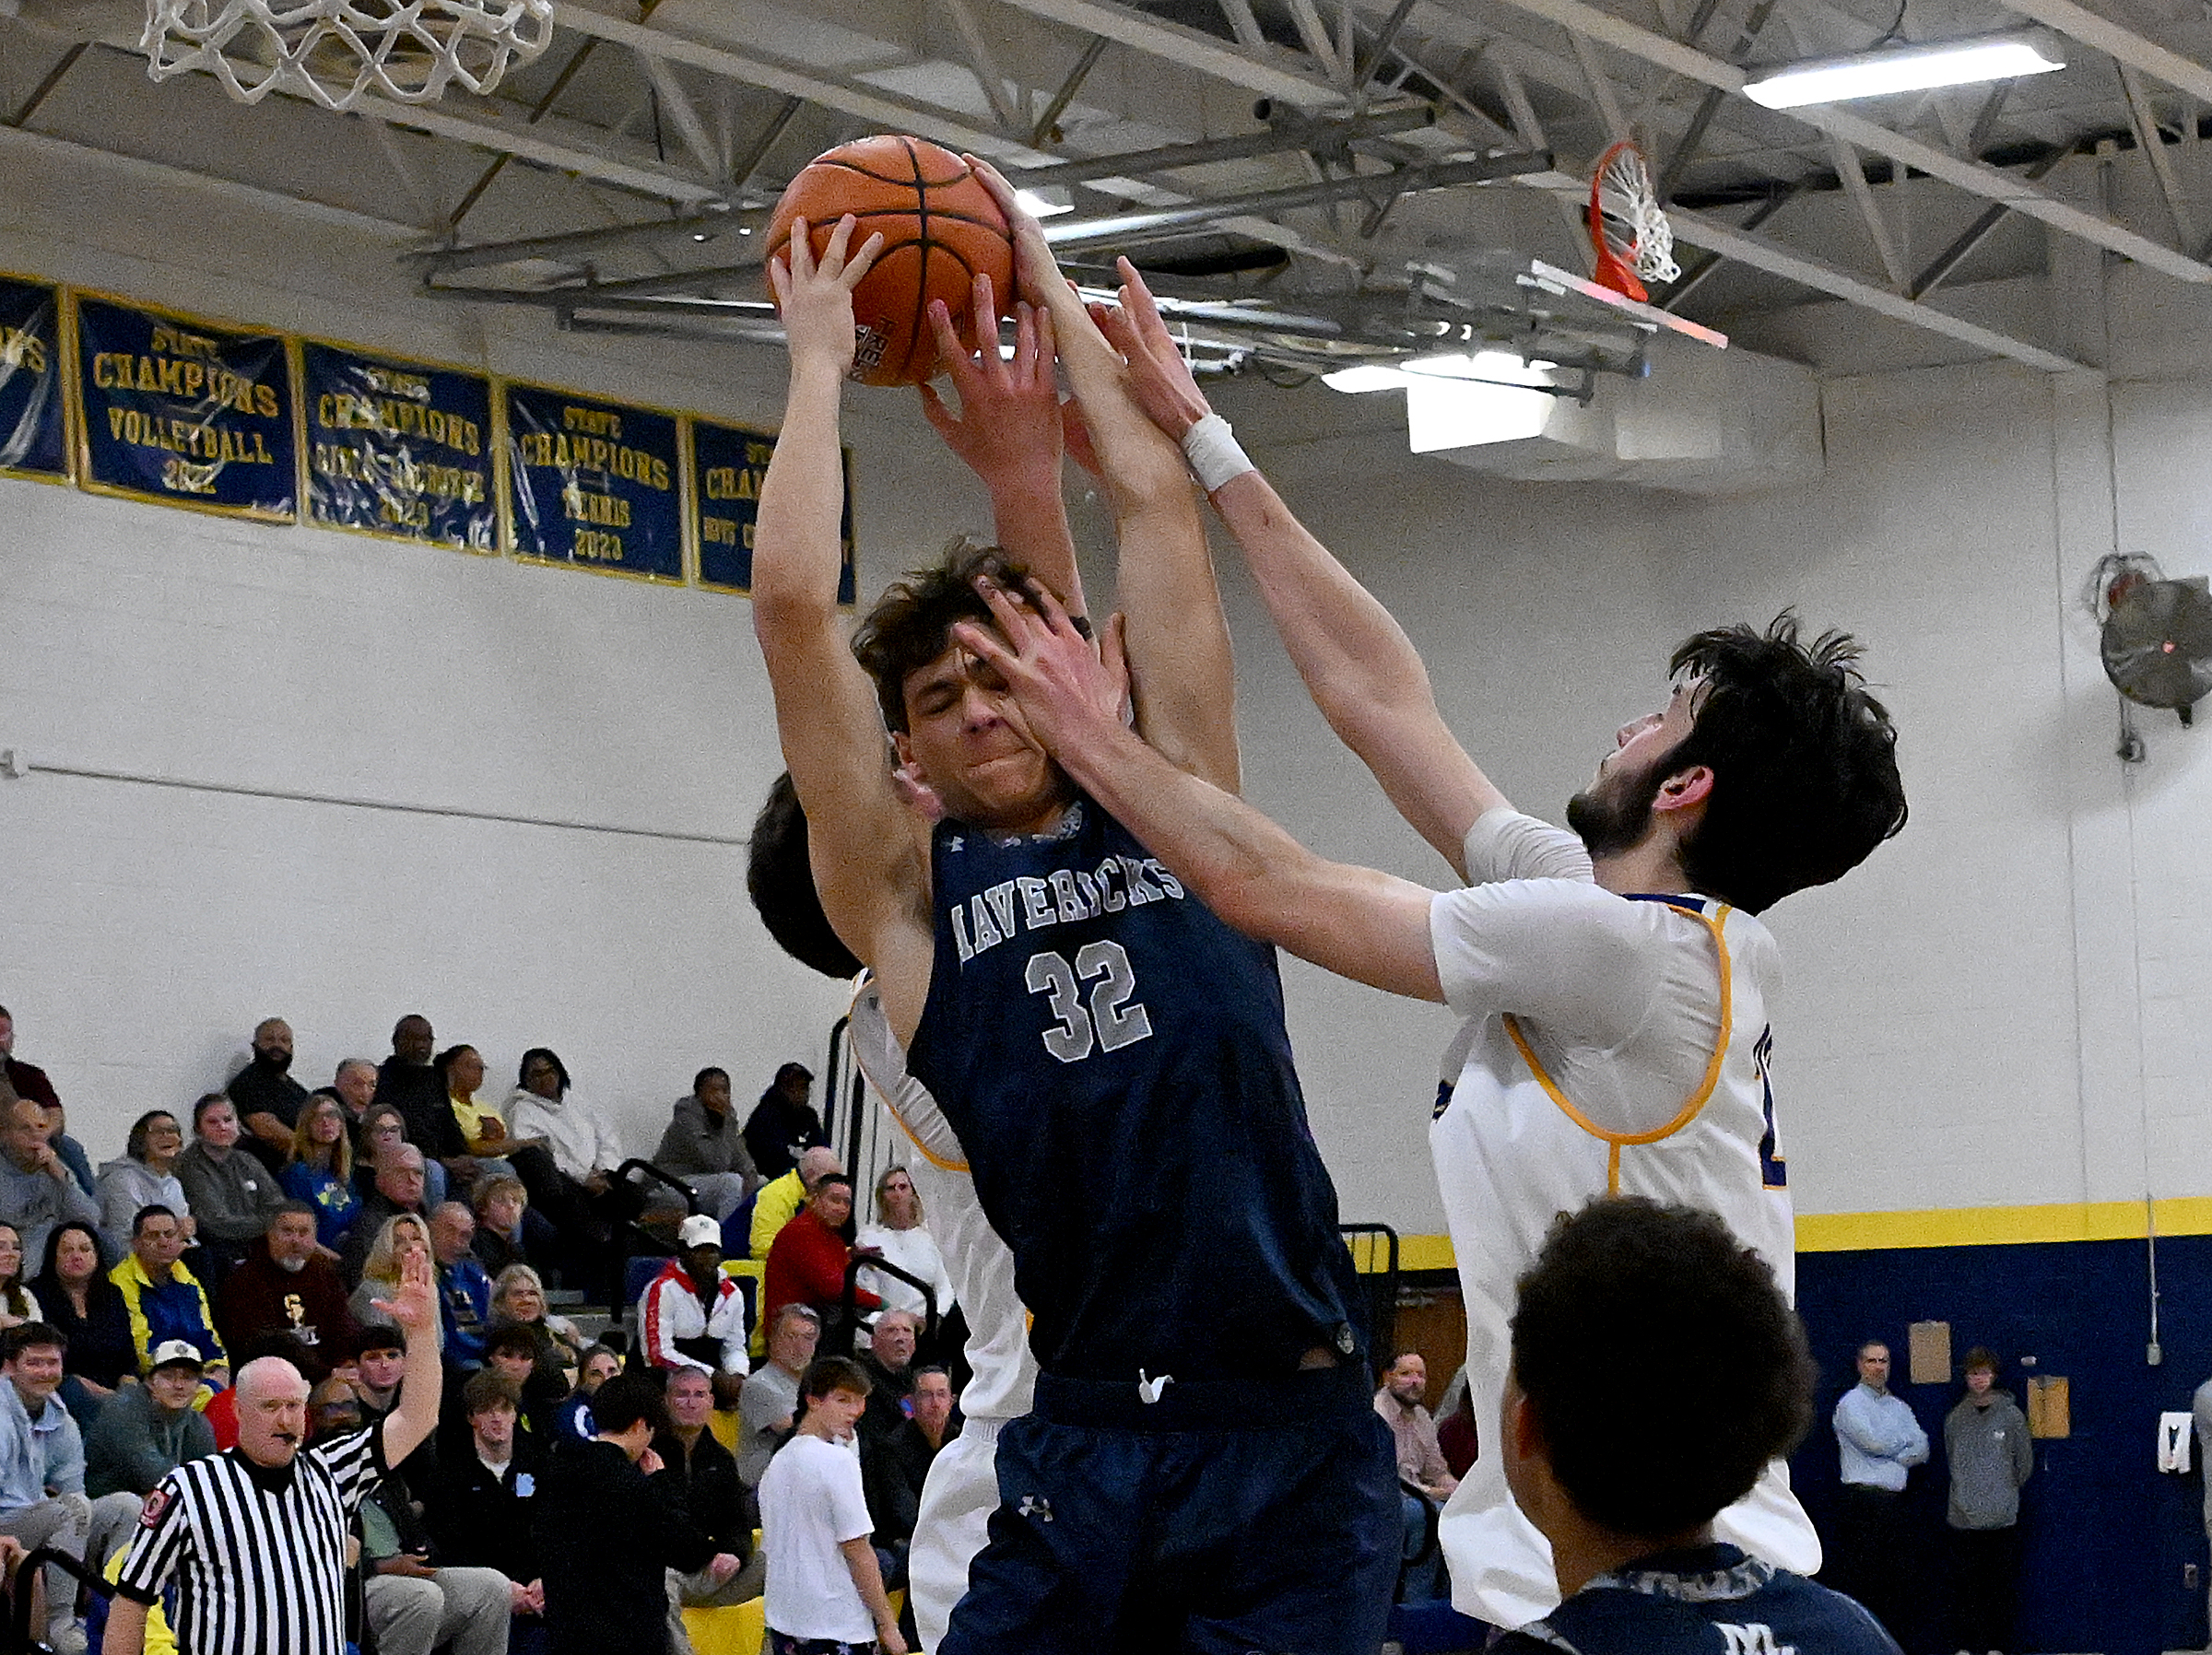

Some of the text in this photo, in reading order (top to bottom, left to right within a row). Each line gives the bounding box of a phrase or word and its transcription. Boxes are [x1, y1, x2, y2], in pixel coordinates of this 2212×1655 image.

[94, 352, 279, 417] CHAMPIONS
[108, 407, 274, 464] VOLLEYBALL
[563, 405, 622, 439] STATE
[522, 431, 670, 490] CHAMPIONS
[1025, 939, 1153, 1063] 32
